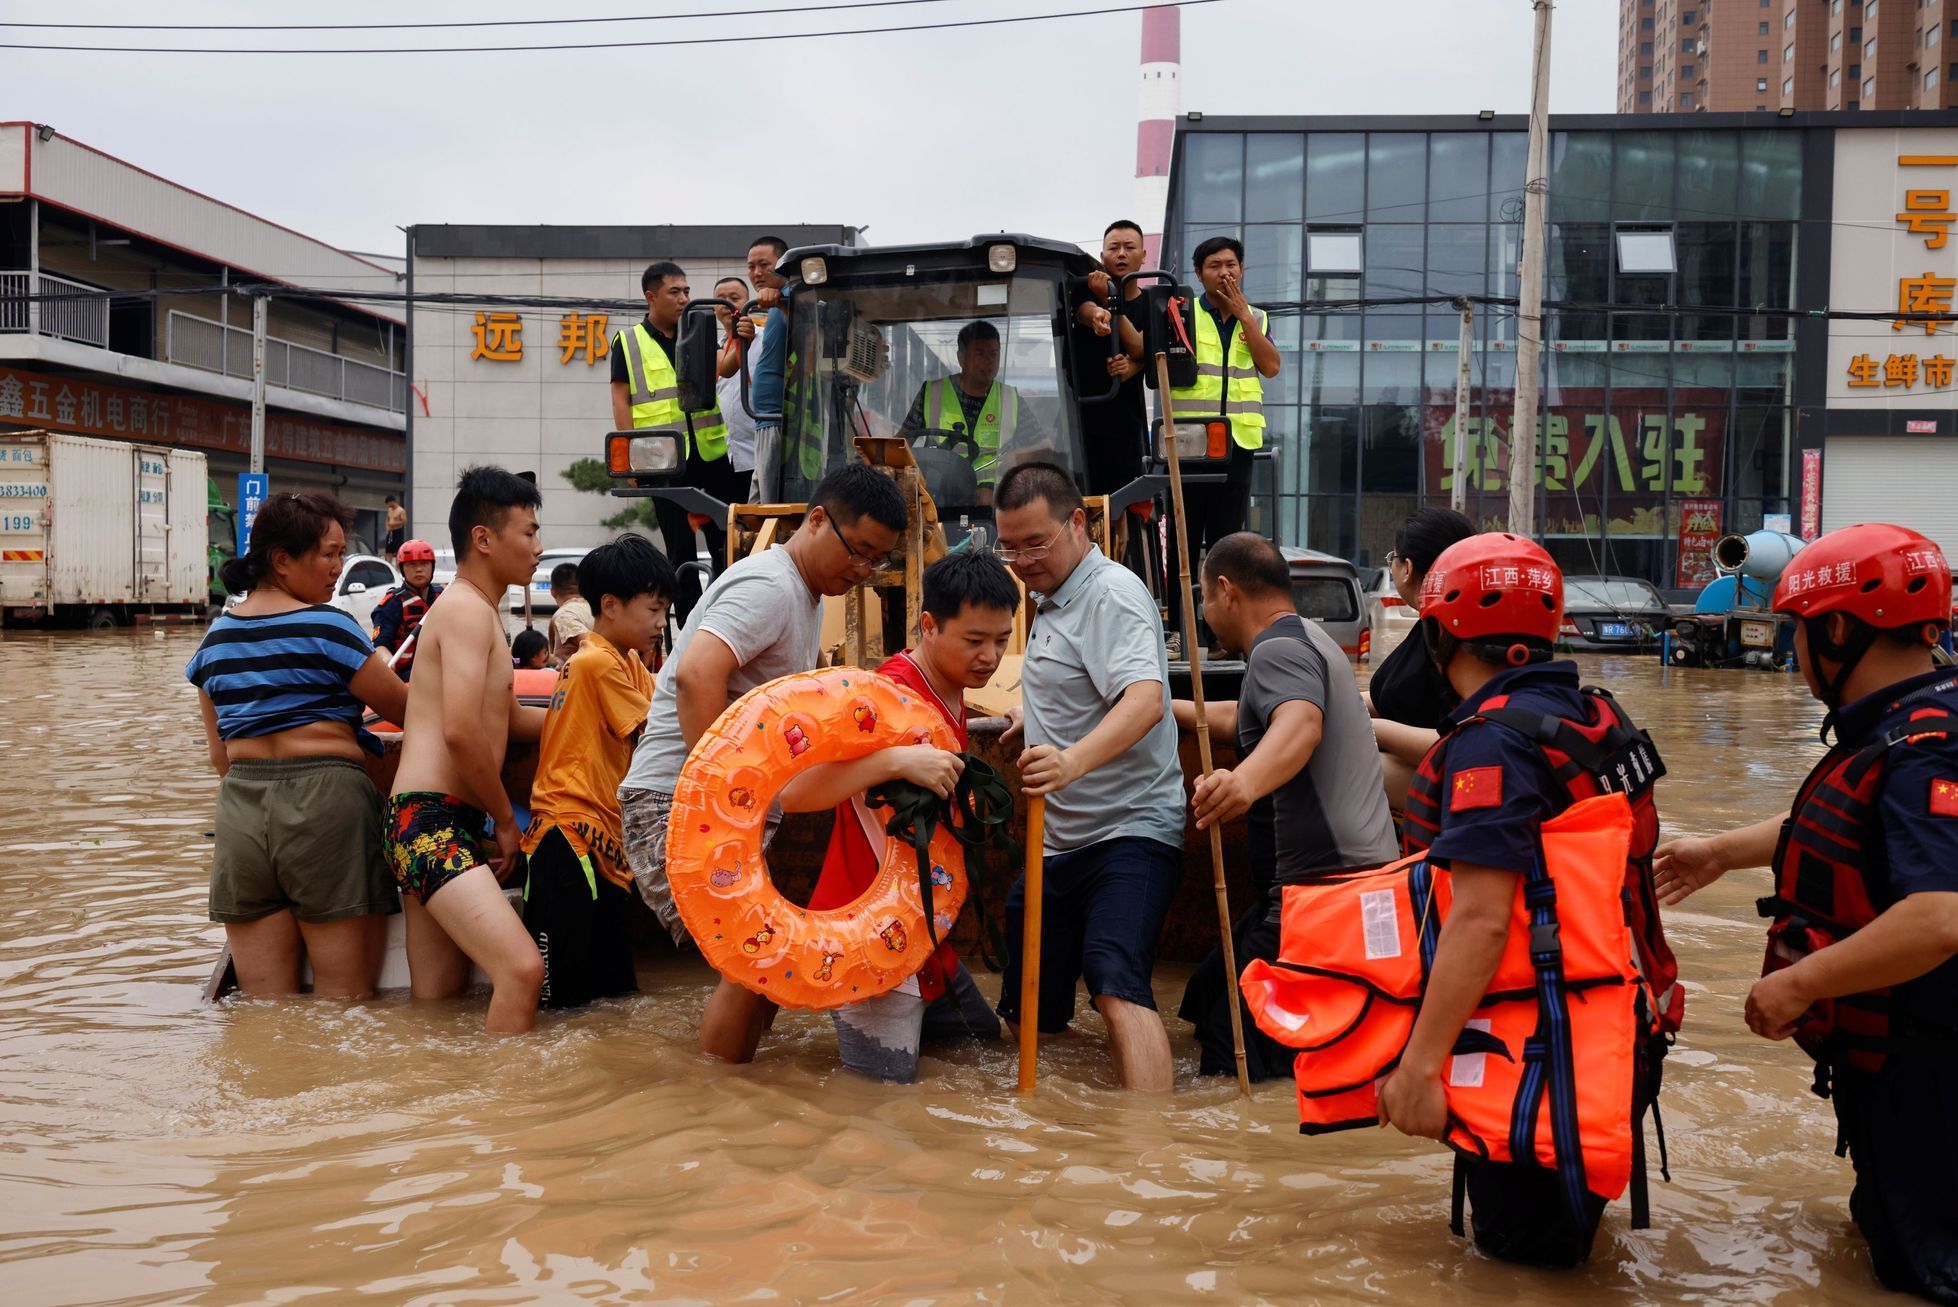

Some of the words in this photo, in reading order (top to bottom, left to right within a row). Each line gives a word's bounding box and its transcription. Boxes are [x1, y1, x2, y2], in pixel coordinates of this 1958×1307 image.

[1891, 155, 1958, 335] 一号库
[470, 310, 610, 366] 远邦
[1848, 353, 1956, 388] 生鲜市
[0, 373, 171, 437] 鑫五金机电商行
[1788, 561, 1852, 594] 阳光救援
